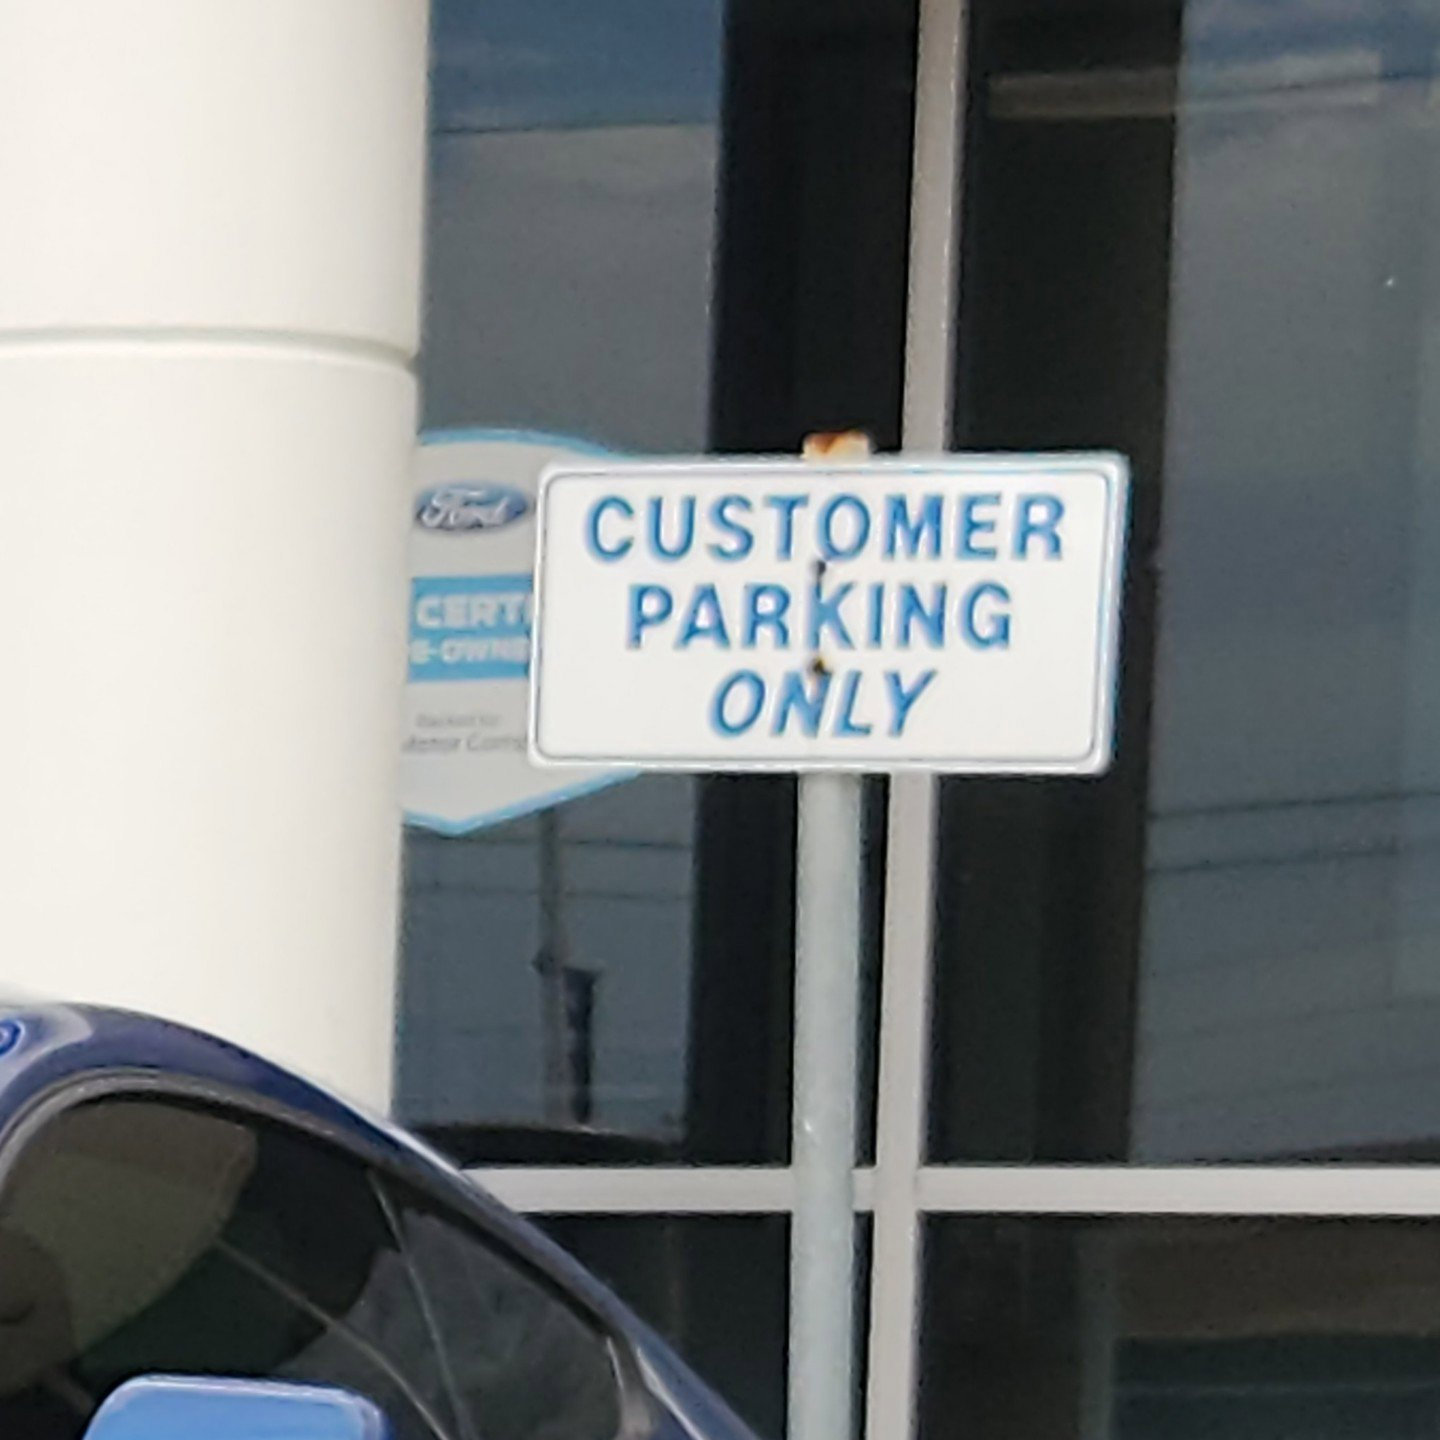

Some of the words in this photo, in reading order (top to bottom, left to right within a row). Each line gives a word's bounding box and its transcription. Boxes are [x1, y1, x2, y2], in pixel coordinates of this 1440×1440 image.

[584, 491, 1066, 564] CUSTOMER
[626, 580, 1013, 652] PARKING
[708, 667, 938, 740] ONLY
